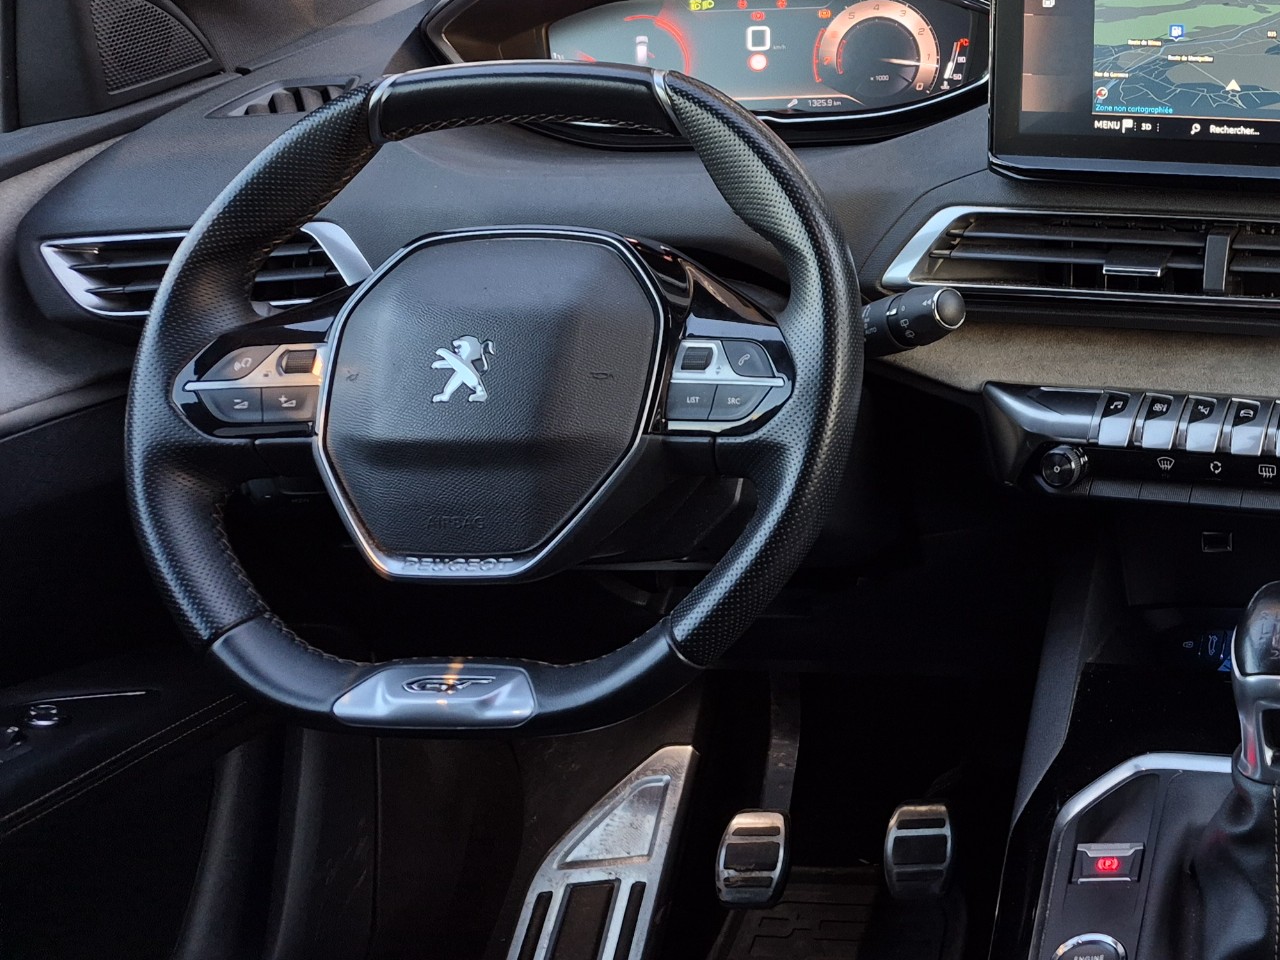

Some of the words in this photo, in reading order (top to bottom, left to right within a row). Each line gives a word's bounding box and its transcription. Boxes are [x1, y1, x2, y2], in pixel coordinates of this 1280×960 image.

[873, 3, 880, 11] 4
[747, 26, 771, 51] 0
[808, 99, 833, 107] 1325.9
[1095, 104, 1112, 112] Zone
[1127, 106, 1173, 115] cartographiée
[1094, 120, 1120, 130] MENU
[1141, 122, 1152, 131] 3D
[1209, 124, 1260, 136] Rechercher...
[727, 397, 740, 405] SRC
[403, 556, 514, 572] PEUGEOT
